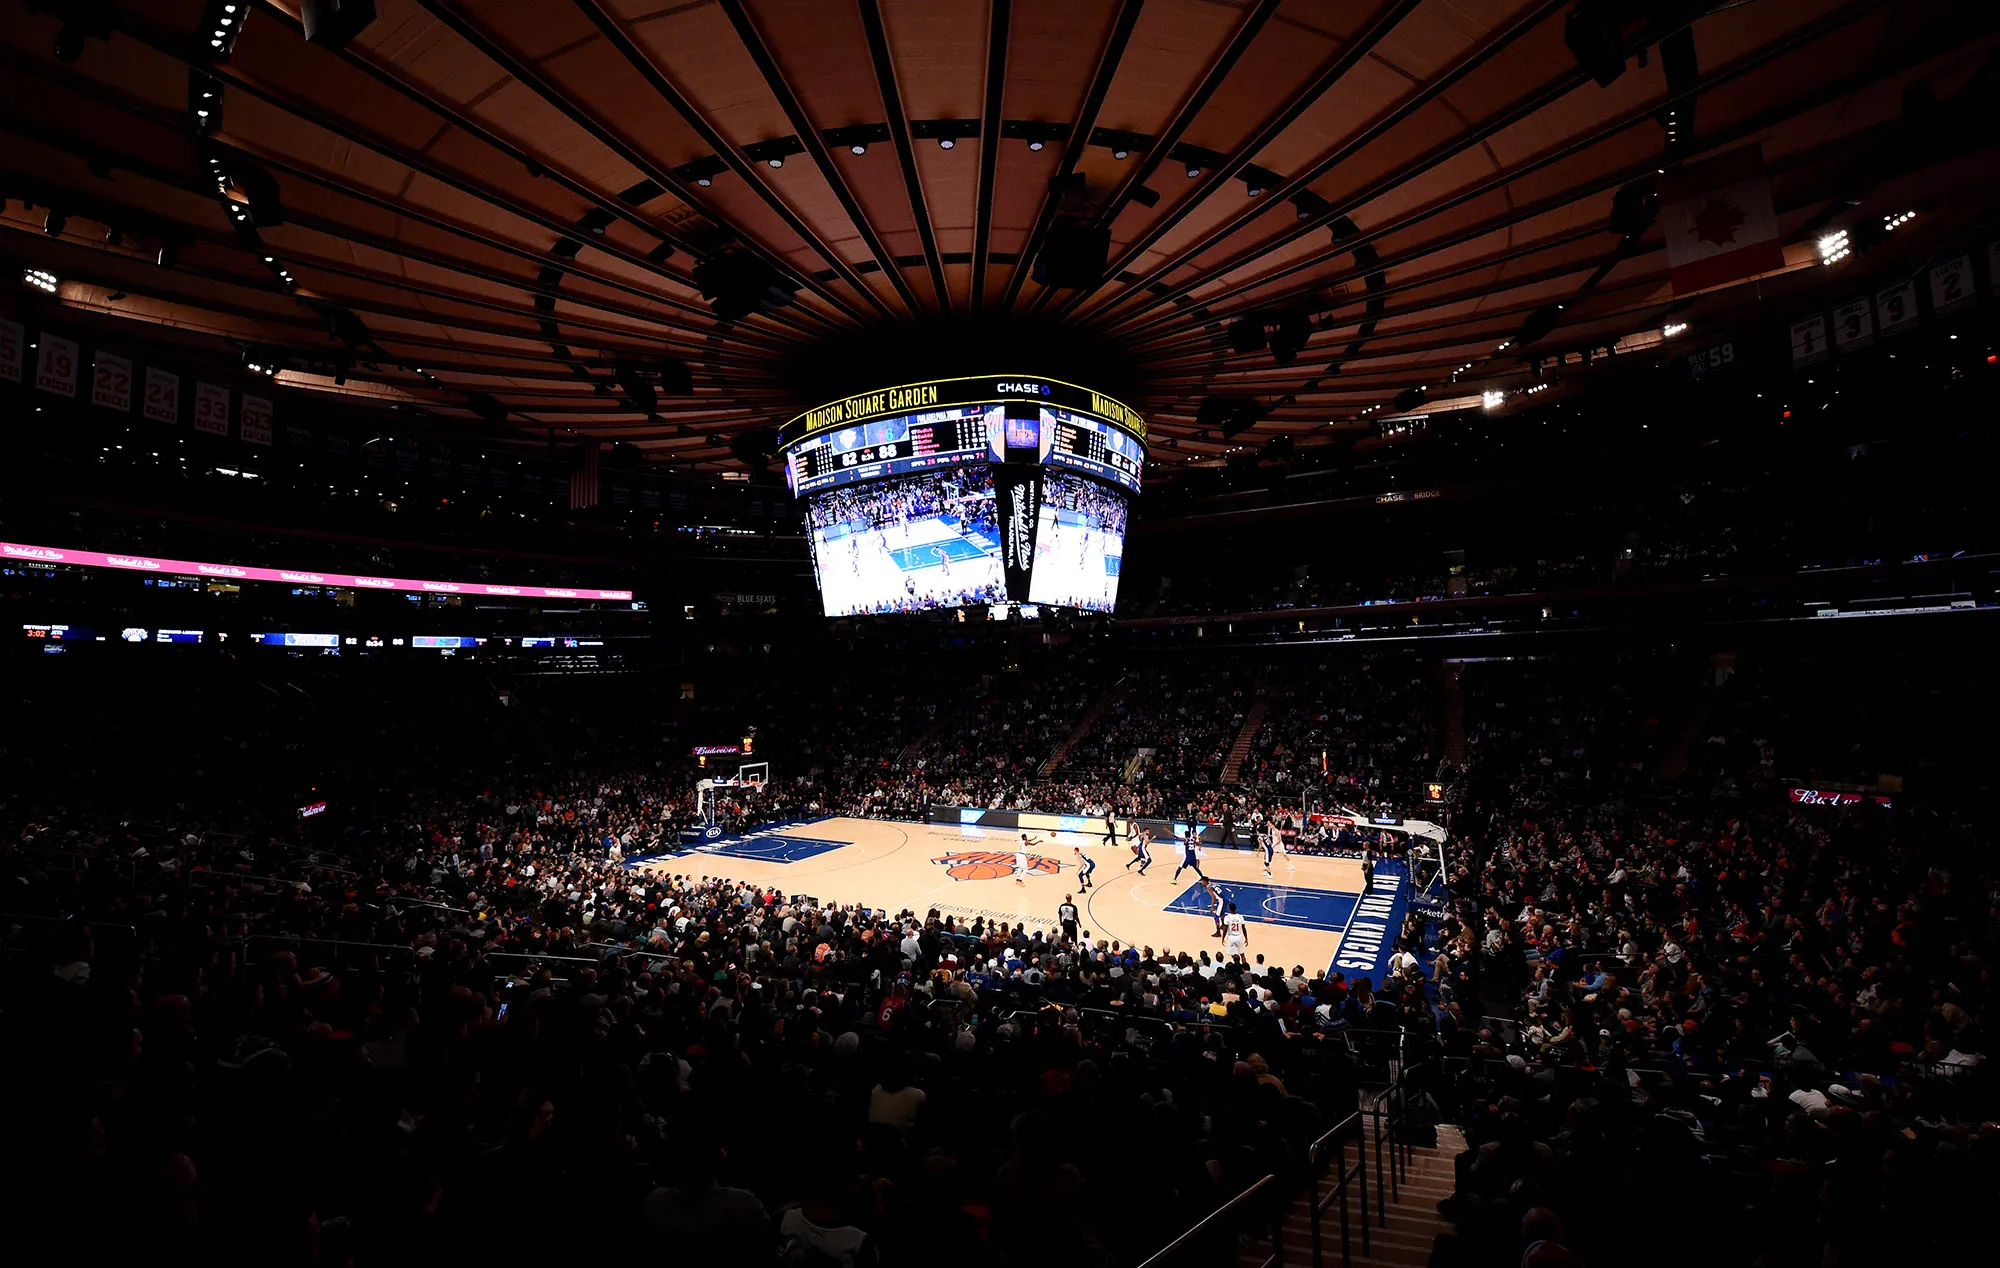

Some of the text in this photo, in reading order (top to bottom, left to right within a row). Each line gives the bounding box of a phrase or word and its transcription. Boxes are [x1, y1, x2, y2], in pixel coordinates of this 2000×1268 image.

[1942, 272, 1962, 302] 2
[45, 351, 72, 378] 19
[1708, 342, 1734, 368] 59
[97, 367, 128, 394] 22
[996, 383, 1039, 394] CHASE
[148, 383, 175, 407] 24
[198, 397, 226, 419] 33
[242, 408, 273, 431] 613
[806, 386, 937, 432] MADISON SQUARE GARDEN
[1091, 393, 1124, 423] MADISON
[196, 418, 226, 433] KNICKS
[842, 452, 857, 467] 82
[879, 444, 897, 459] 88
[1375, 490, 1441, 504] CHASE BRIDGE
[1013, 484, 1029, 534] Mitchell
[1020, 542, 1032, 570] Ness
[736, 595, 776, 603] BLUE SEATS
[27, 630, 46, 638] 3:02
[694, 746, 737, 756] Budweiser
[709, 828, 719, 836] KIA
[1356, 894, 1396, 920] YORK
[1231, 923, 1239, 932] 21
[1336, 921, 1387, 971] KNICKS
[881, 1007, 893, 1022] 6
